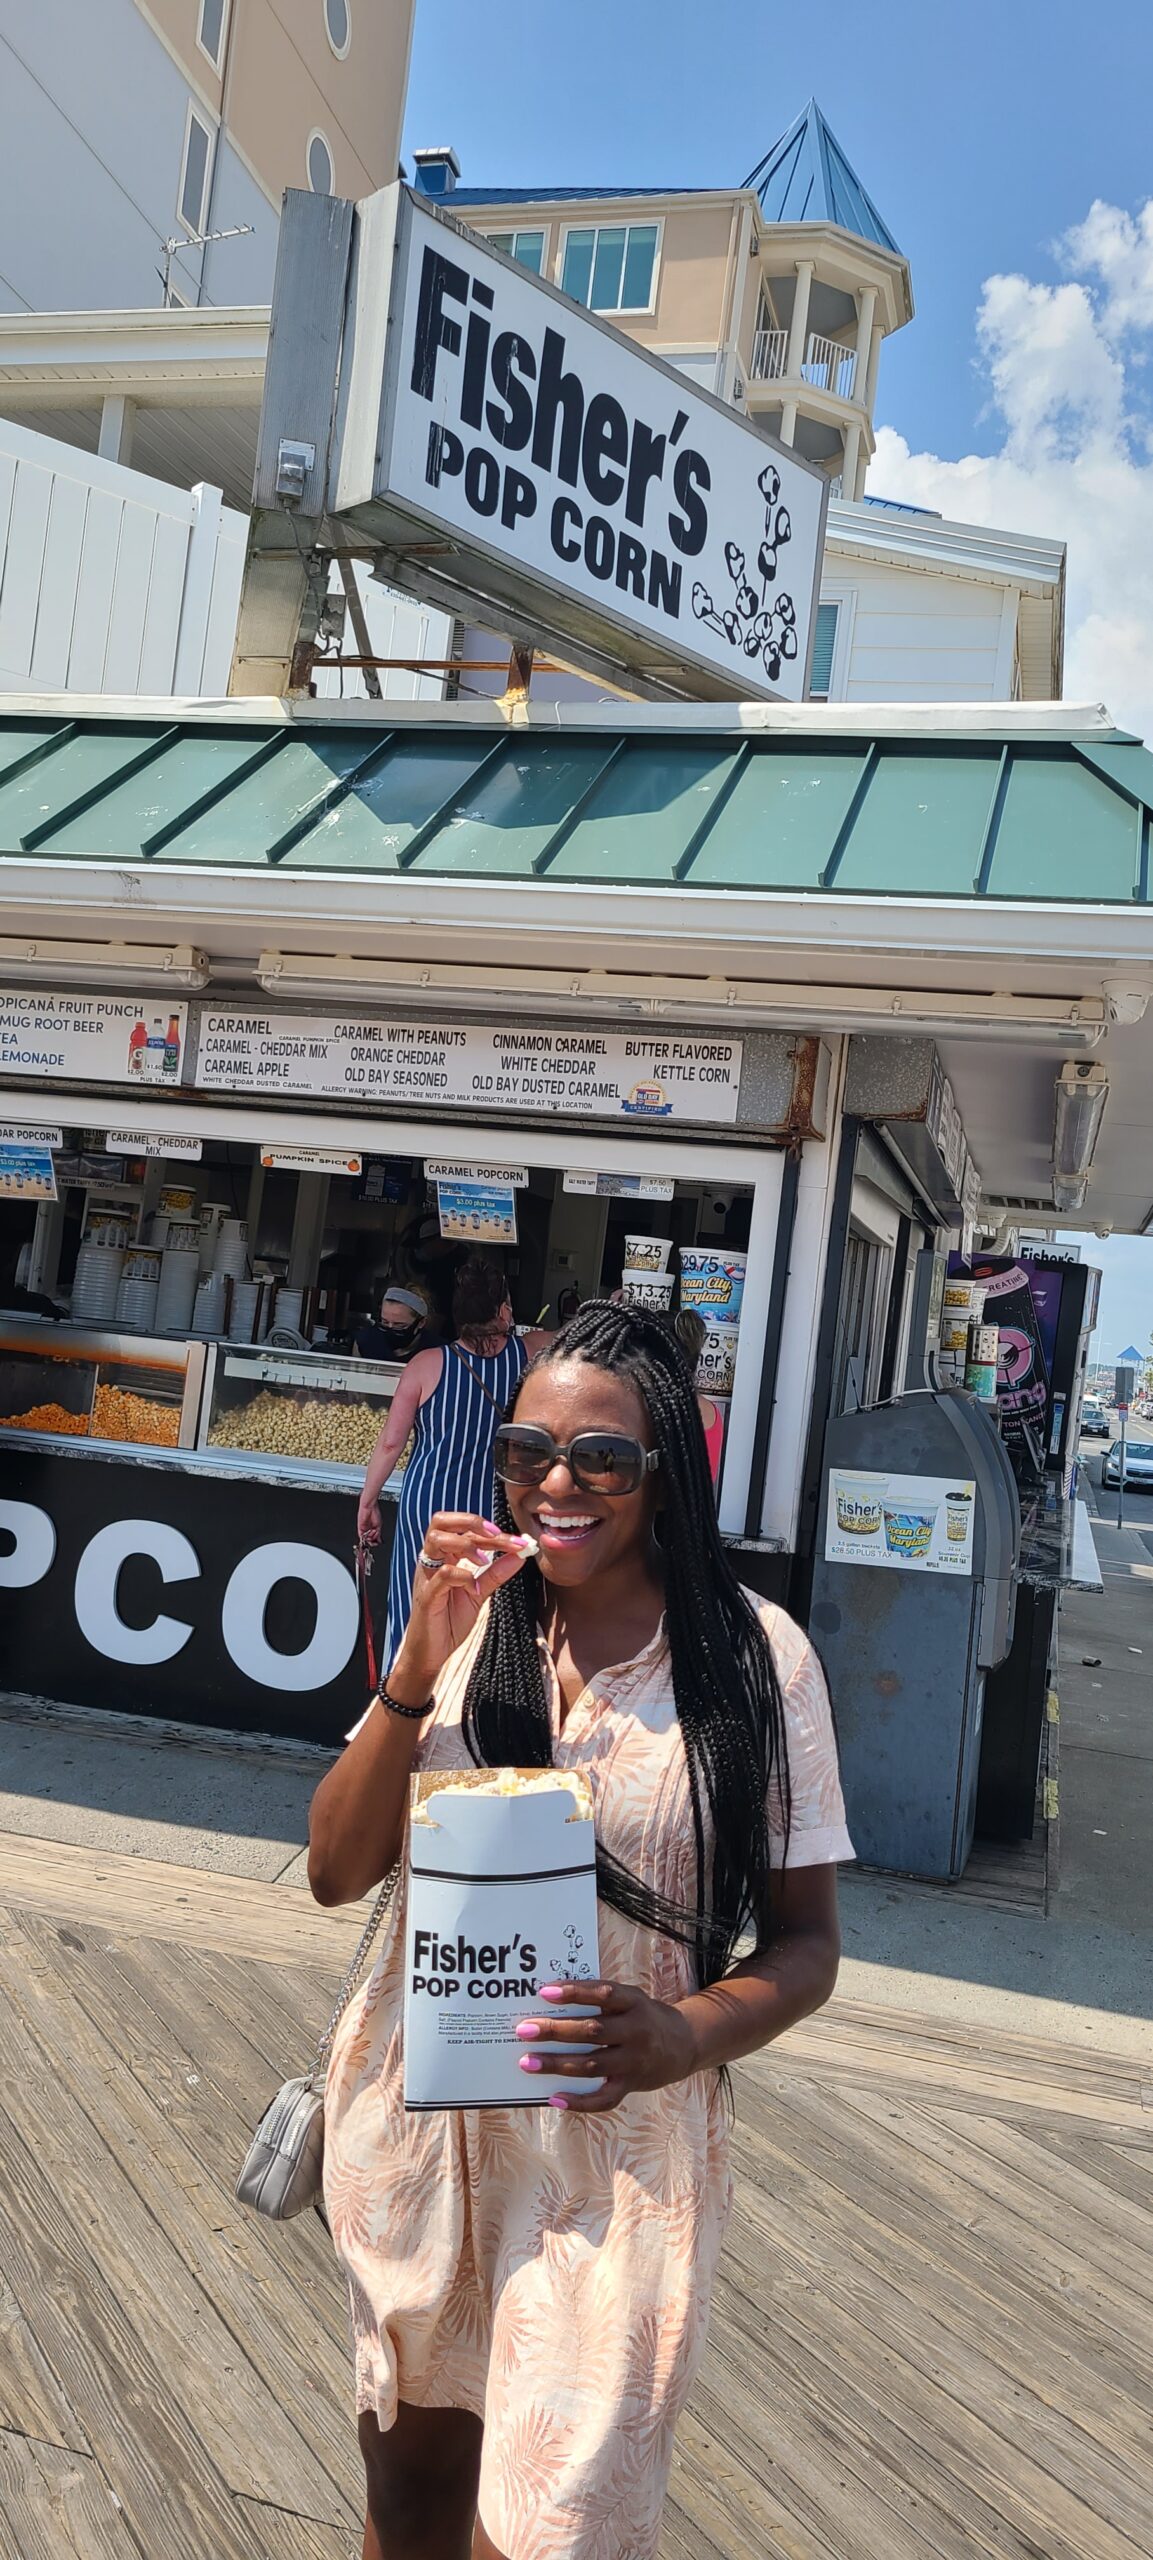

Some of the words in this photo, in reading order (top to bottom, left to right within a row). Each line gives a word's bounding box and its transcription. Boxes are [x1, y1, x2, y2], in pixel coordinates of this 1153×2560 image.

[411, 244, 711, 556] Fisher's
[425, 421, 537, 531] POP
[551, 496, 682, 619] CORN
[59, 1001, 94, 1015] FRUIT
[97, 1004, 144, 1018] PUNCH
[0, 1015, 31, 1028] MUG
[34, 1018, 70, 1032] ROOT
[73, 1021, 104, 1034] BEER
[208, 1018, 272, 1035] CARAMEL
[334, 1025, 383, 1042] CARAMEL
[387, 1028, 414, 1043] WITH
[417, 1030, 467, 1046] PEANUTS
[492, 1034, 552, 1051] CINNAMON
[555, 1037, 607, 1054] CARAMEL
[206, 1038, 252, 1054] CARAMEL
[260, 1041, 306, 1058] CHEDDAR
[309, 1045, 328, 1059] MIX
[350, 1047, 393, 1063] ORANGE
[396, 1049, 446, 1066] CHEDDAR
[625, 1041, 669, 1057] BUTTER
[672, 1044, 733, 1061] FLAVORED
[205, 1059, 253, 1075] CARAMEL
[256, 1062, 290, 1077] APPLE
[501, 1056, 538, 1071] WHITE
[541, 1058, 596, 1075] CHEDDAR
[653, 1064, 695, 1080] KETTLE
[699, 1067, 730, 1083] CORN
[283, 1082, 313, 1090] CARAMEL
[345, 1067, 365, 1082] OLD
[368, 1069, 390, 1084] BAY
[393, 1070, 448, 1087] SEASONED
[472, 1075, 493, 1090] OLD
[496, 1077, 519, 1092] BAY
[522, 1079, 565, 1094] DUSTED
[568, 1081, 621, 1098] CARAMEL
[321, 1085, 346, 1093] ALLERGY
[348, 1087, 377, 1096] WARNING:
[425, 1091, 441, 1099] NUTS
[472, 1095, 504, 1103] PRODUCTS
[562, 1101, 592, 1109] LOCATION
[17, 1130, 58, 1142] POPCORN
[111, 1132, 150, 1145] CARAMEL
[158, 1137, 198, 1150] CHEDDAR
[145, 1146, 161, 1156] MIX
[270, 1154, 314, 1163] PUMPKIN
[428, 1164, 474, 1178] CARAMEL
[477, 1168, 524, 1181] POPCORN
[641, 1185, 657, 1193] PLUS
[838, 1497, 882, 1517] Fisher's
[887, 1524, 914, 1537] Ocean
[831, 1546, 855, 1555] $28.50
[856, 1549, 876, 1557] PLUS
[878, 1550, 892, 1558] TAX
[413, 1929, 537, 1974] Fisher's
[413, 1975, 460, 1998] POP
[467, 1977, 537, 1998] CORN
